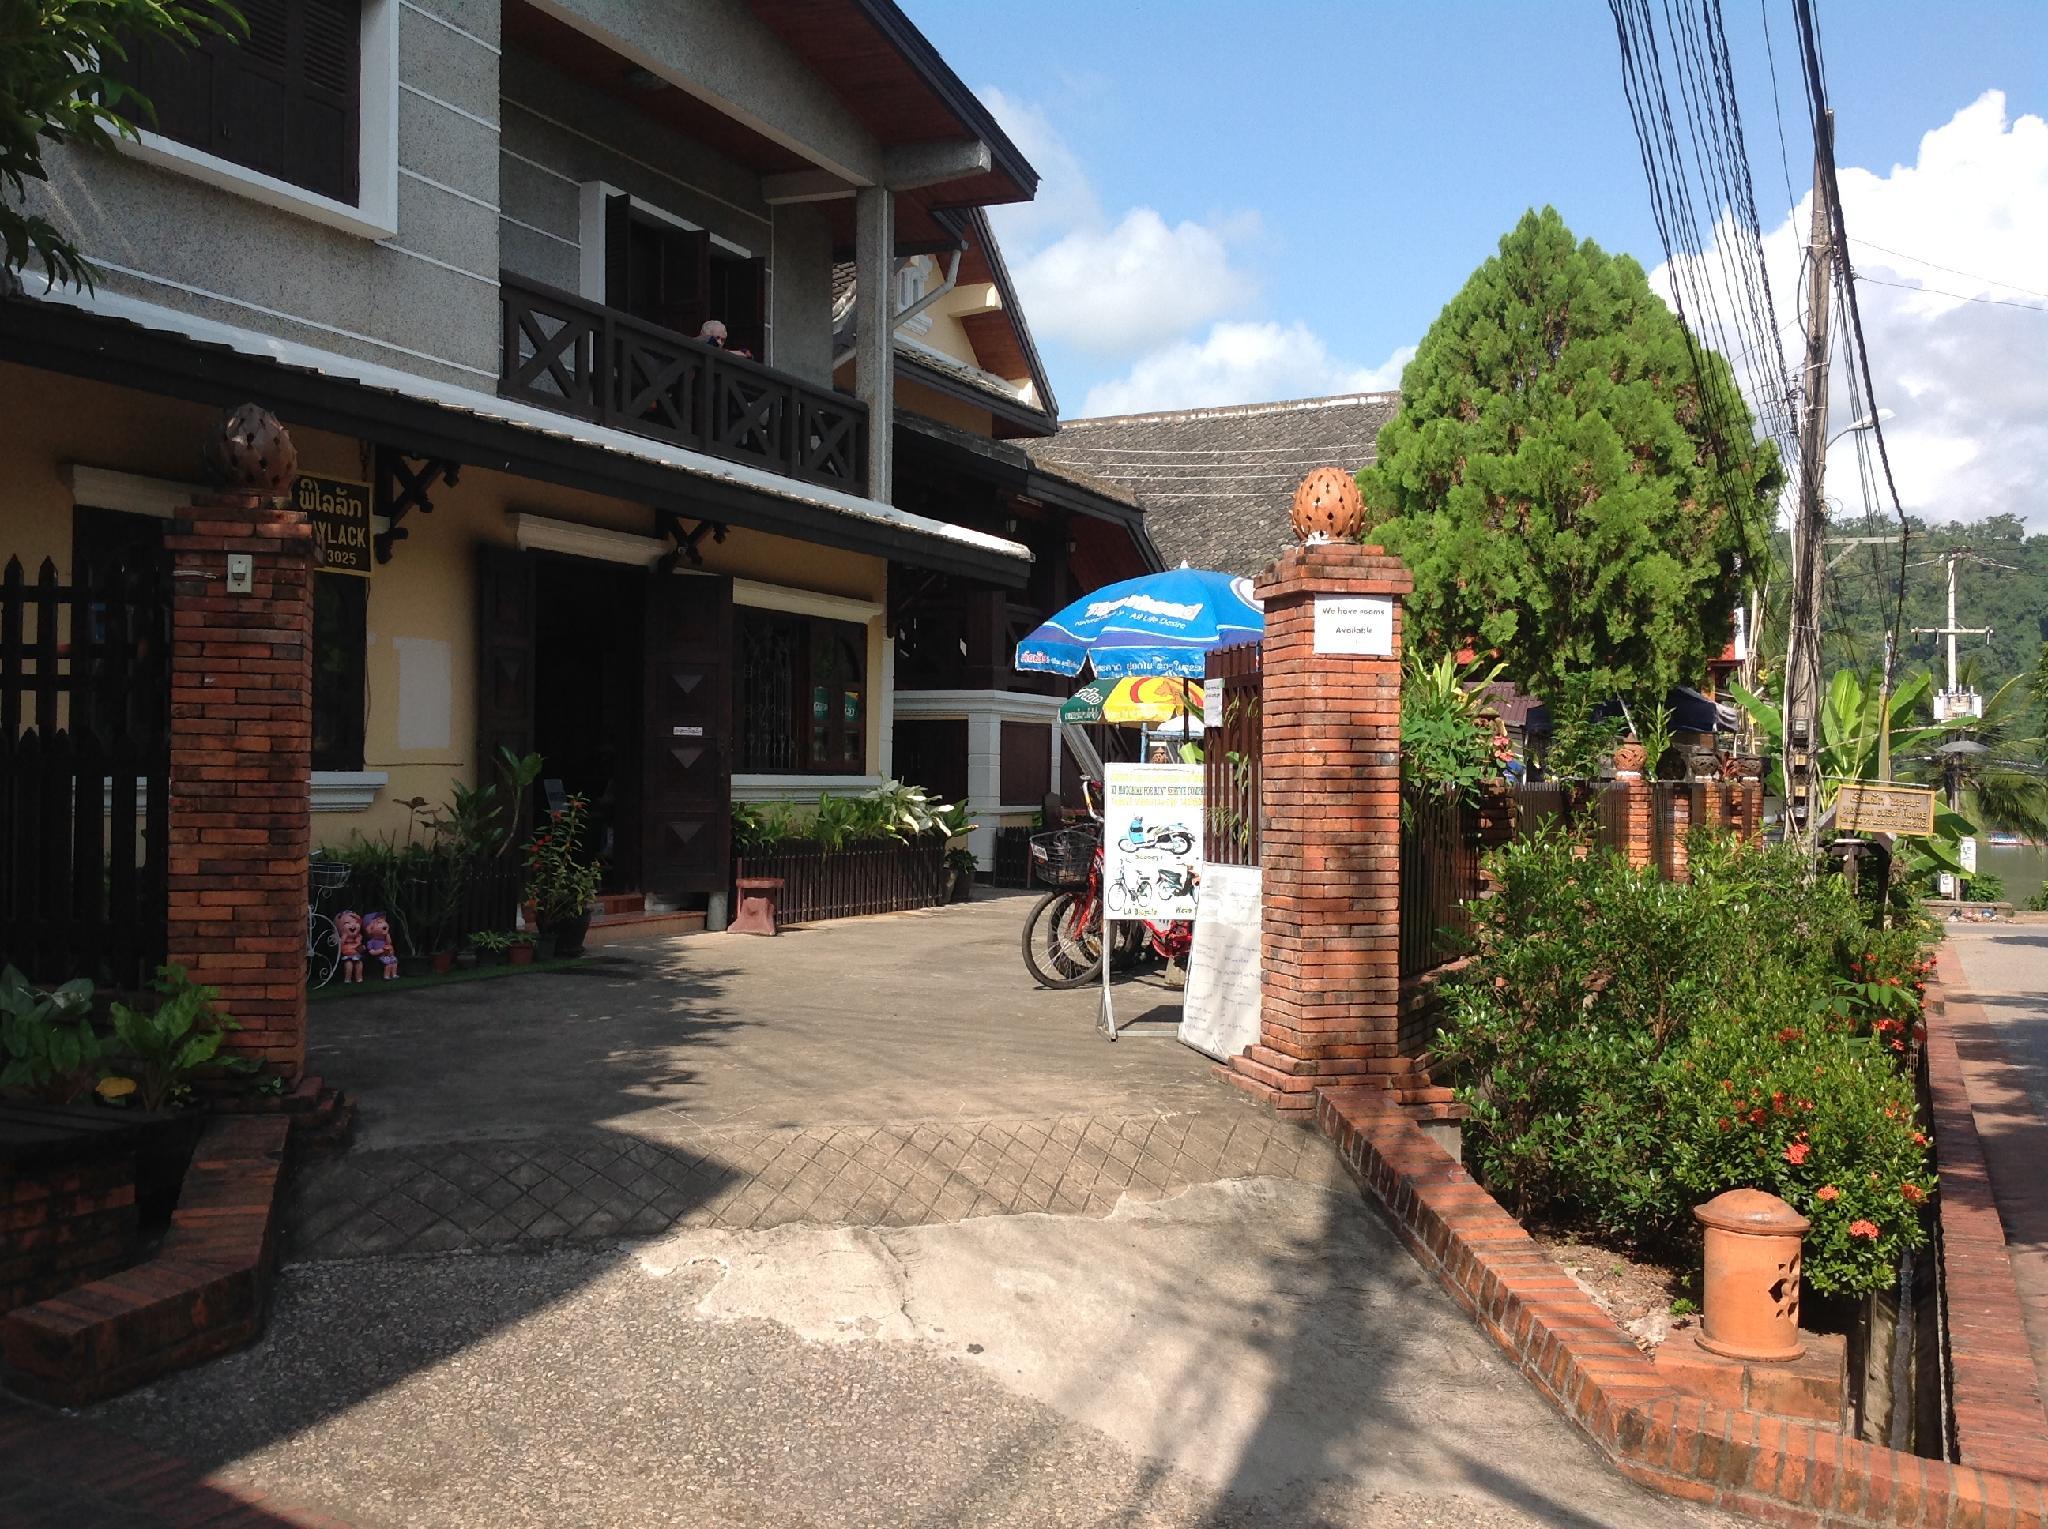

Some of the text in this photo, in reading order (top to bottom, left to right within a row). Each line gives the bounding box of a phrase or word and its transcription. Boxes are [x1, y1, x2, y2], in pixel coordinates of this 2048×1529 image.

[327, 549, 357, 566] 3025
[1322, 607, 1336, 615] We
[1337, 606, 1358, 615] have
[1335, 625, 1373, 634] Available
